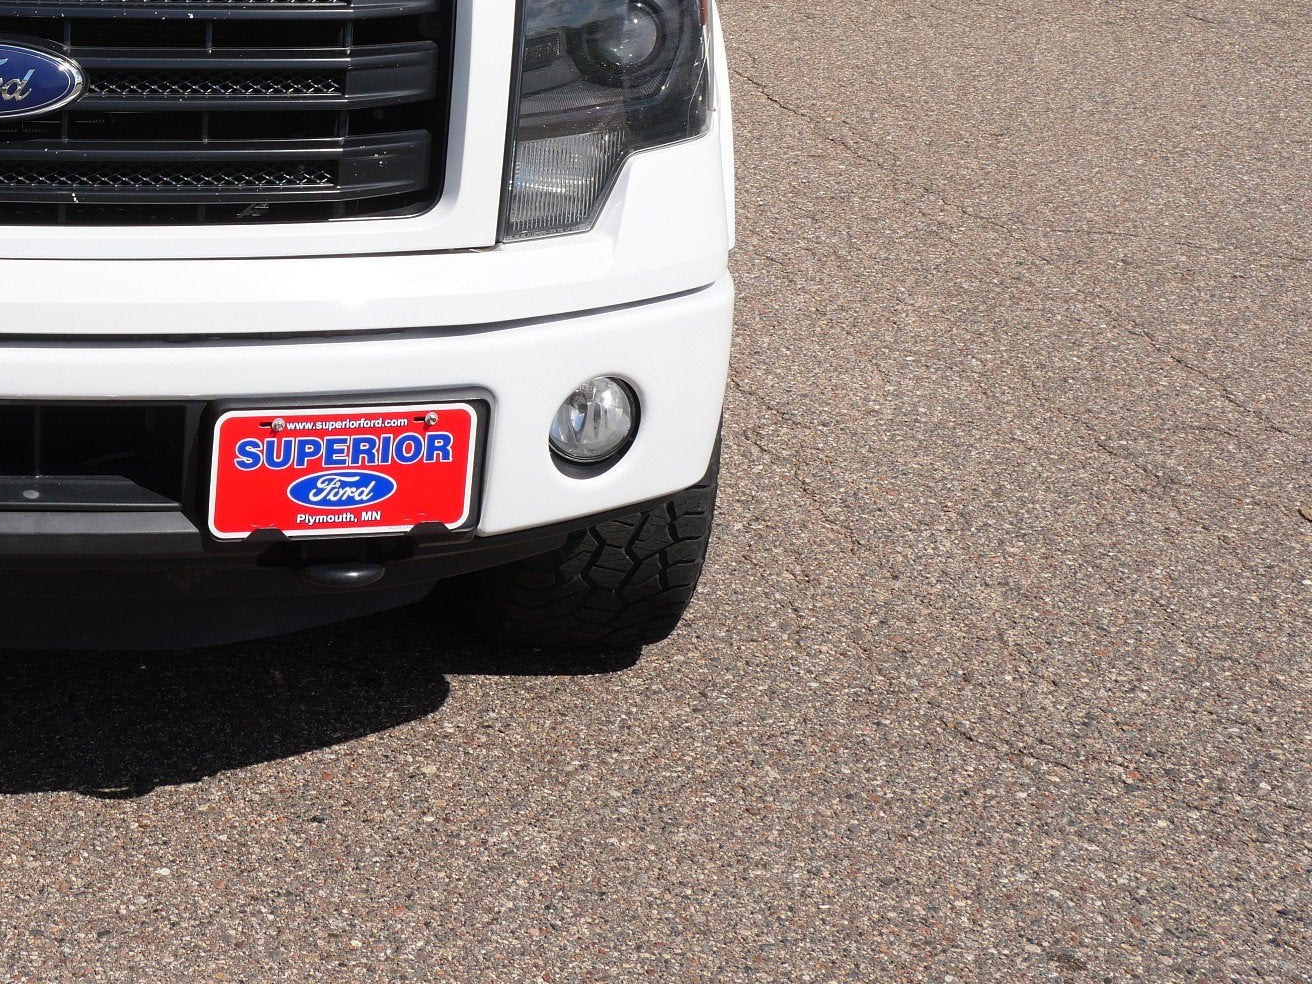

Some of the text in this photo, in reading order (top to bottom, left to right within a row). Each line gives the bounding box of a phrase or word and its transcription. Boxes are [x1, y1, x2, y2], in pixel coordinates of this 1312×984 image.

[286, 418, 408, 431] www.superiorford.com
[233, 432, 454, 471] SUPERIOR
[308, 474, 377, 503] Ford
[296, 510, 381, 525] Plymouth, MN
